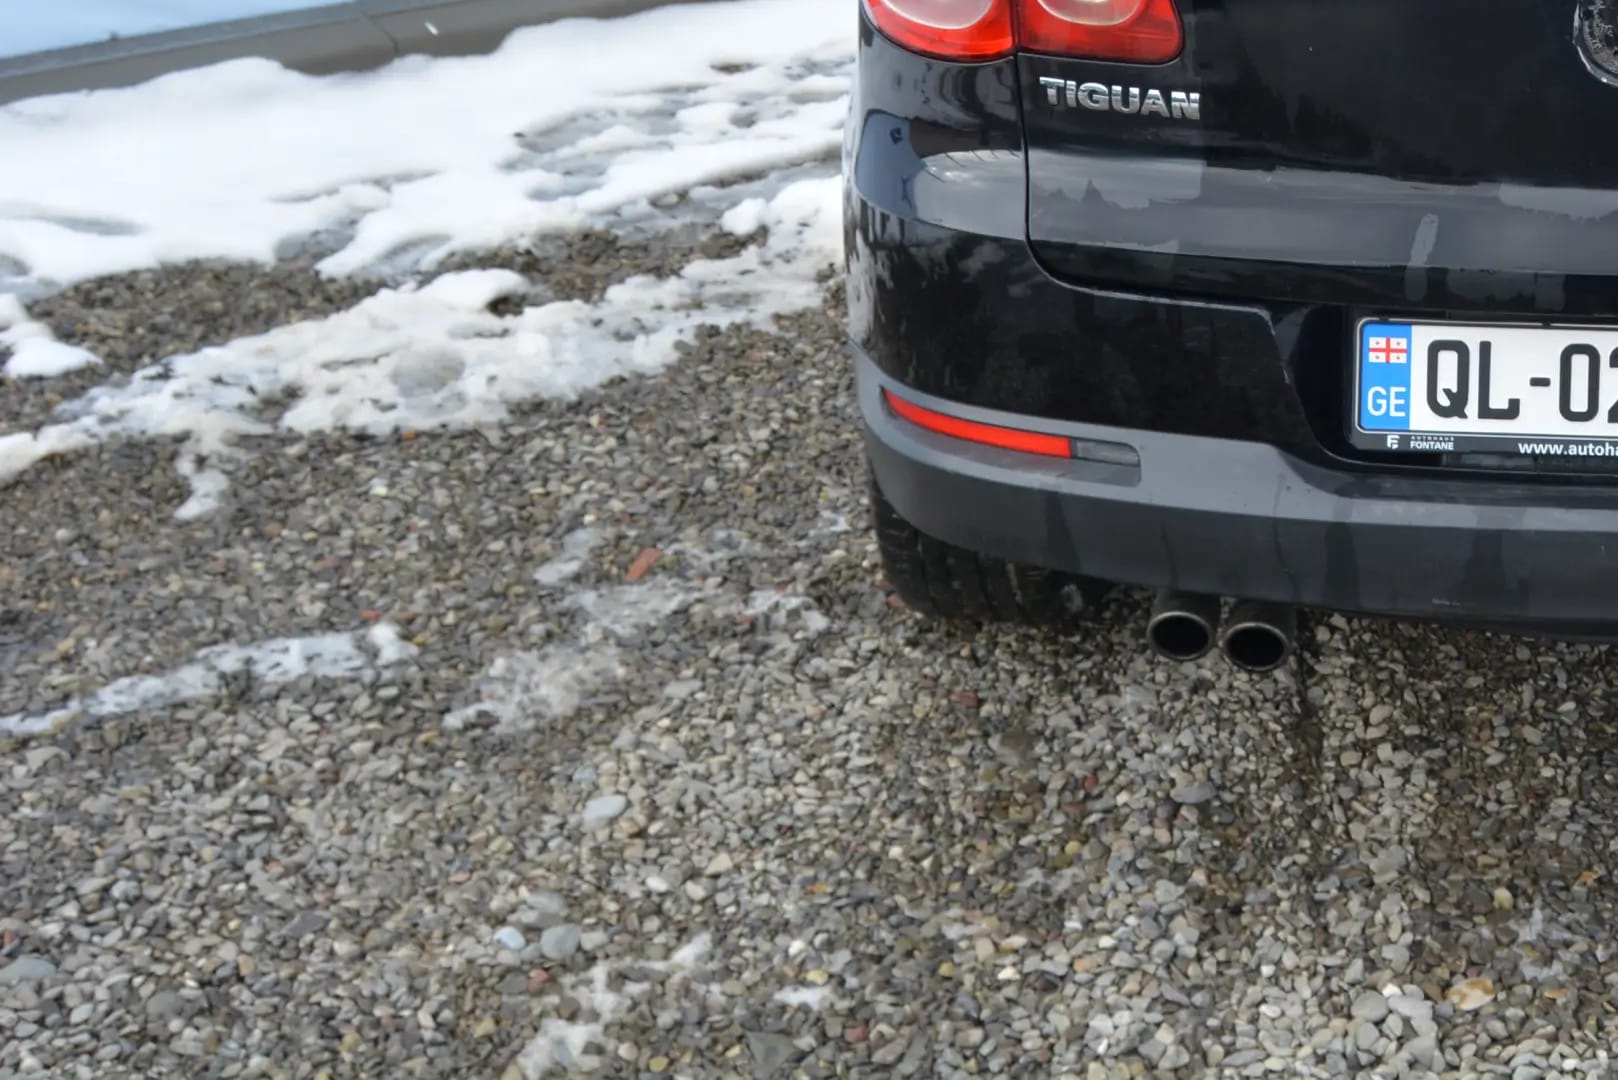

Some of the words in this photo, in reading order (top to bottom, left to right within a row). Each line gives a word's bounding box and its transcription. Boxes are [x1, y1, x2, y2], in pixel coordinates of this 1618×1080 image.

[1038, 76, 1201, 120] TIGUAN
[1367, 386, 1407, 417] GE
[1410, 441, 1454, 450] FONTANE
